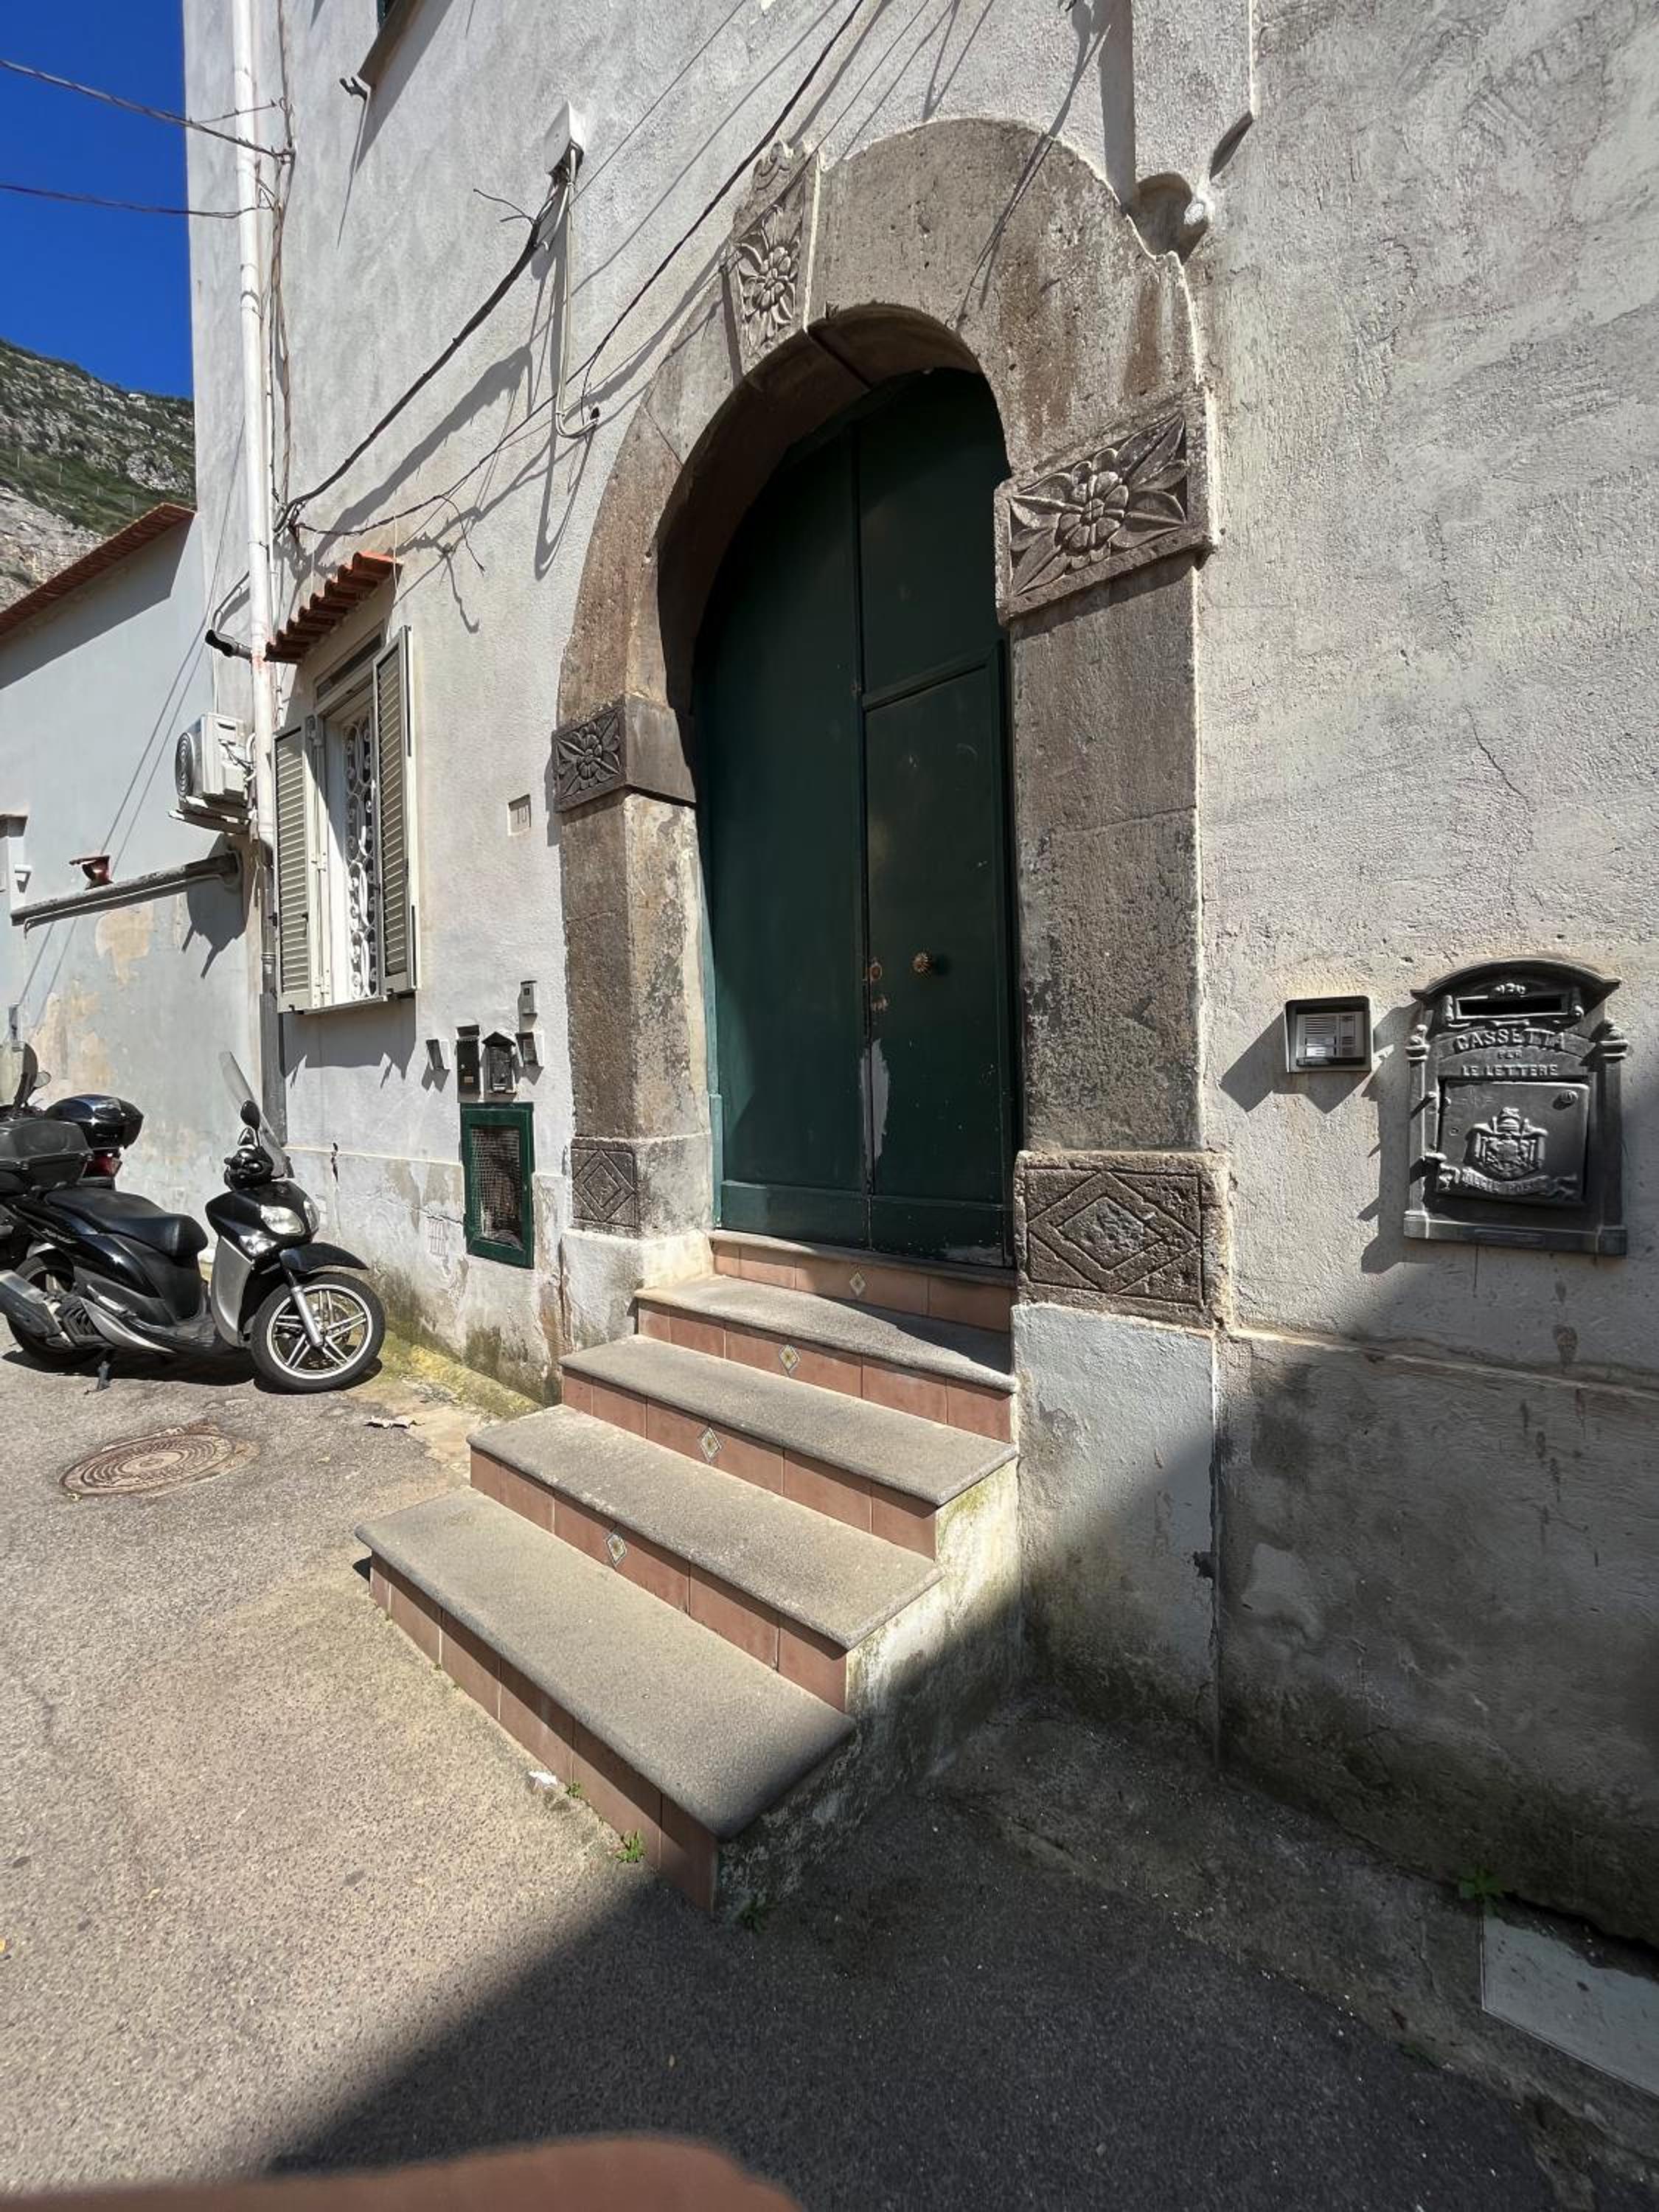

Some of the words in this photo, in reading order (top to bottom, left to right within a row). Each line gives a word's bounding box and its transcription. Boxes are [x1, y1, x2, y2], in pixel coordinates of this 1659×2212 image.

[1454, 1028, 1565, 1051] CASSETTA
[1498, 1048, 1523, 1060] PER
[1462, 1065, 1480, 1076] LE
[1486, 1064, 1558, 1076] LETTERE
